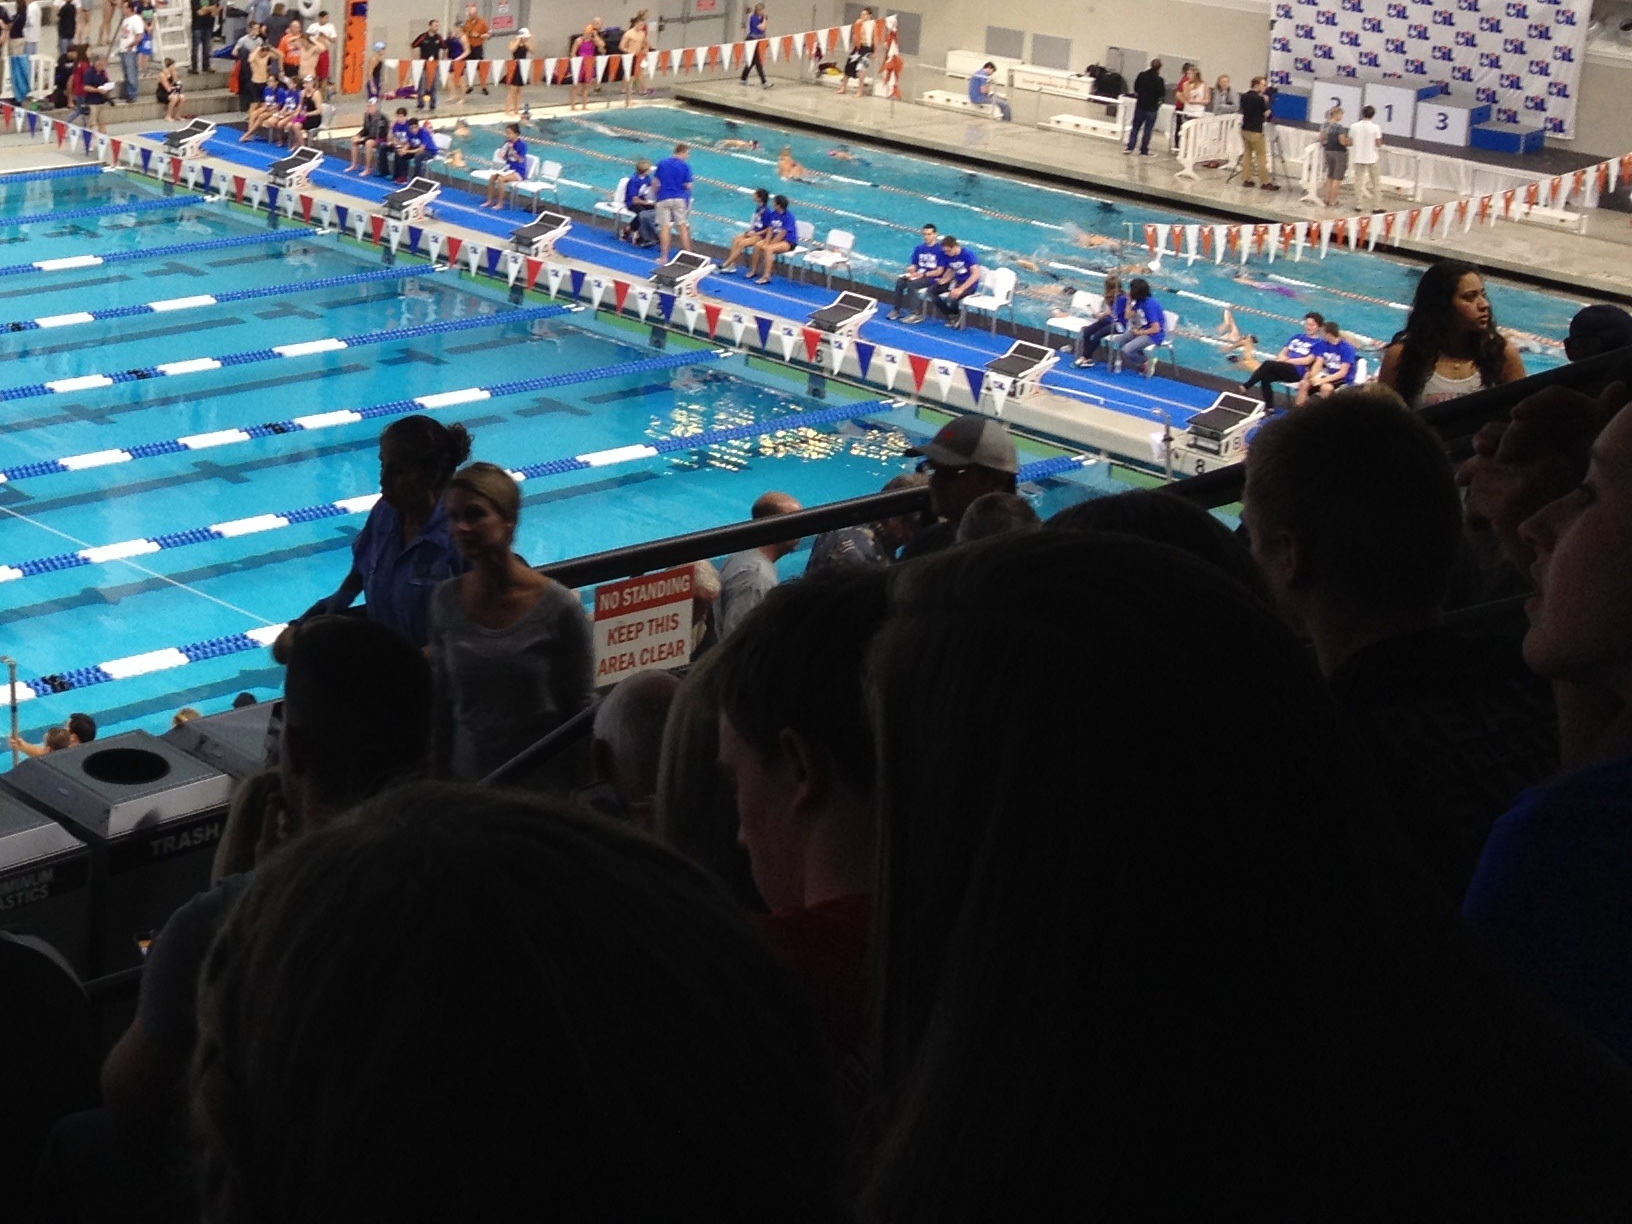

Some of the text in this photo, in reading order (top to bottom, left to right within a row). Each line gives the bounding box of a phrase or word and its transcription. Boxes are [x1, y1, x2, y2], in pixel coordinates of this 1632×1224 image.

[1384, 104, 1394, 122] 1
[1435, 112, 1449, 130] 3
[599, 575, 690, 611] NO STANDING
[607, 613, 679, 646] KEEP THIS
[598, 639, 685, 676] AREA CLEAR
[149, 823, 218, 856] TRASH
